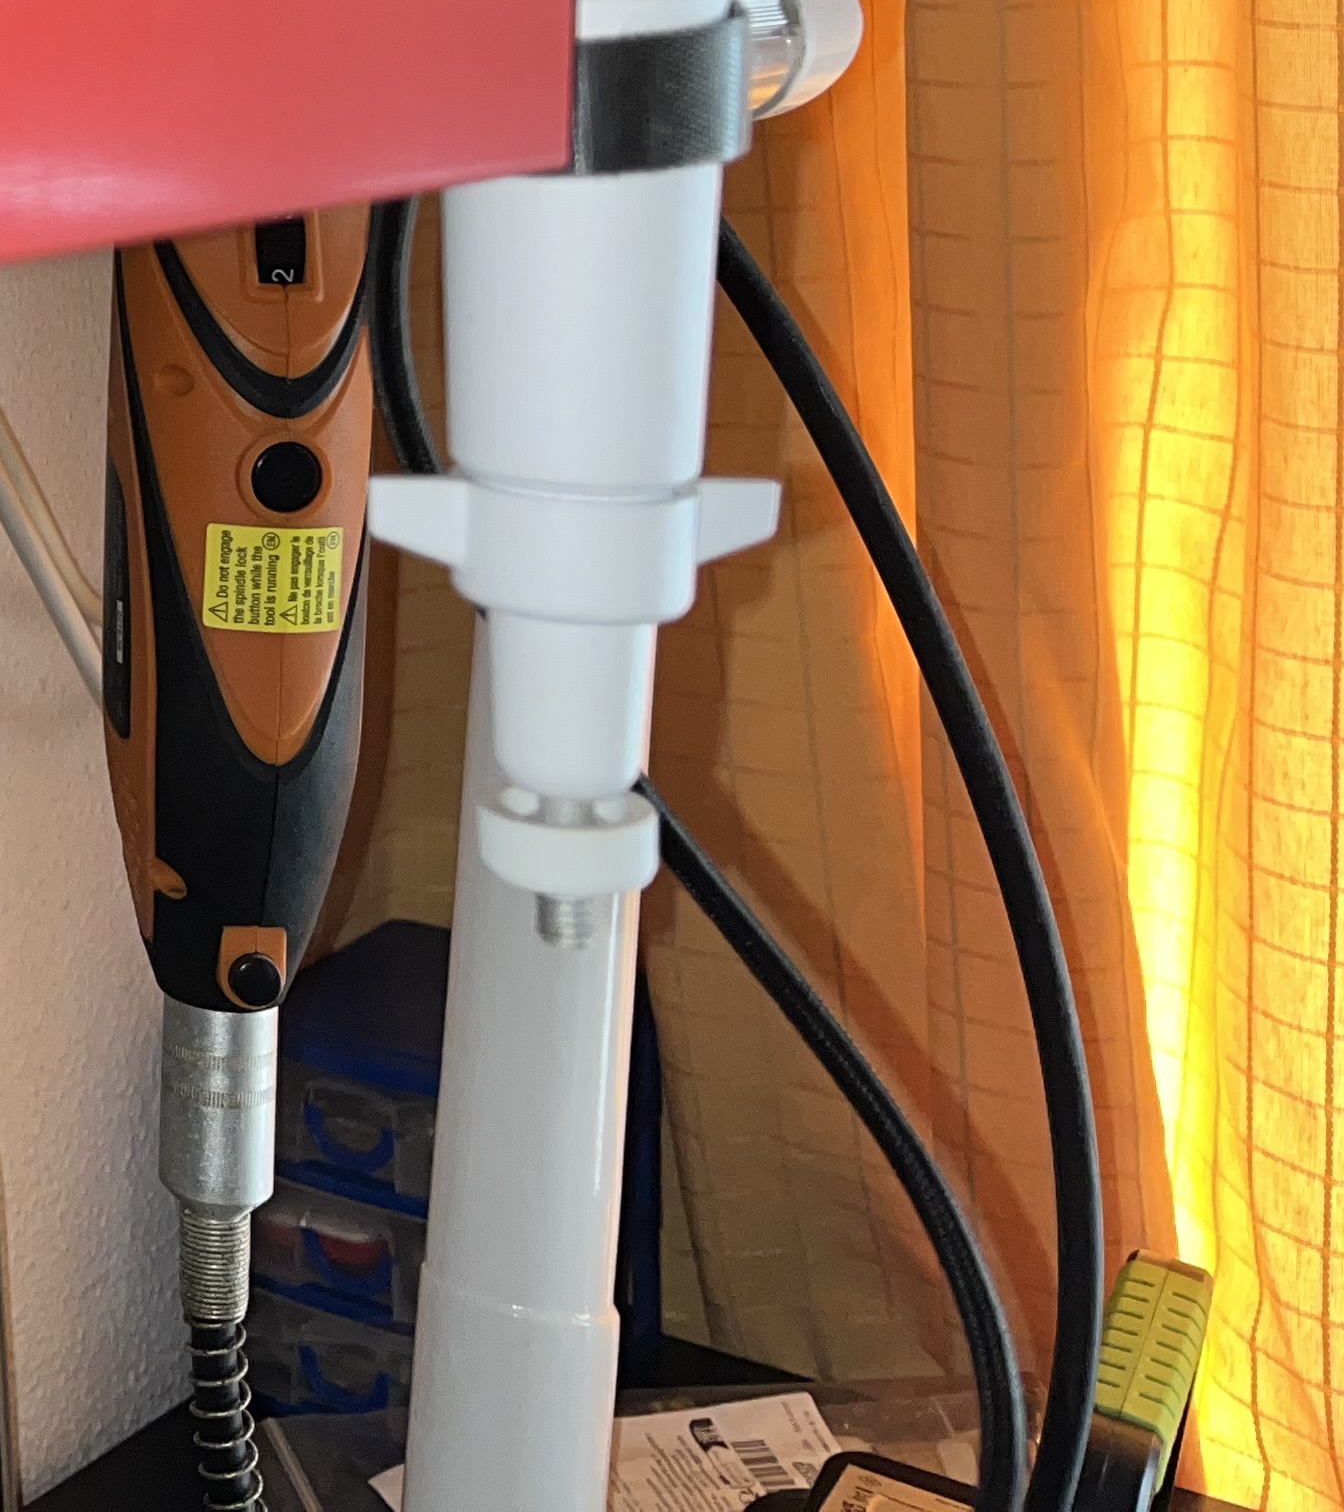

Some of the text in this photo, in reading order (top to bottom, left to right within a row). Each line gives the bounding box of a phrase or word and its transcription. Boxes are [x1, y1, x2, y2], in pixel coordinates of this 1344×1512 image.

[271, 269, 294, 283] 2
[216, 530, 234, 598] Do not engage
[233, 546, 247, 623] the spindle lock
[248, 545, 263, 625] button while the
[264, 554, 280, 626] tool is running
